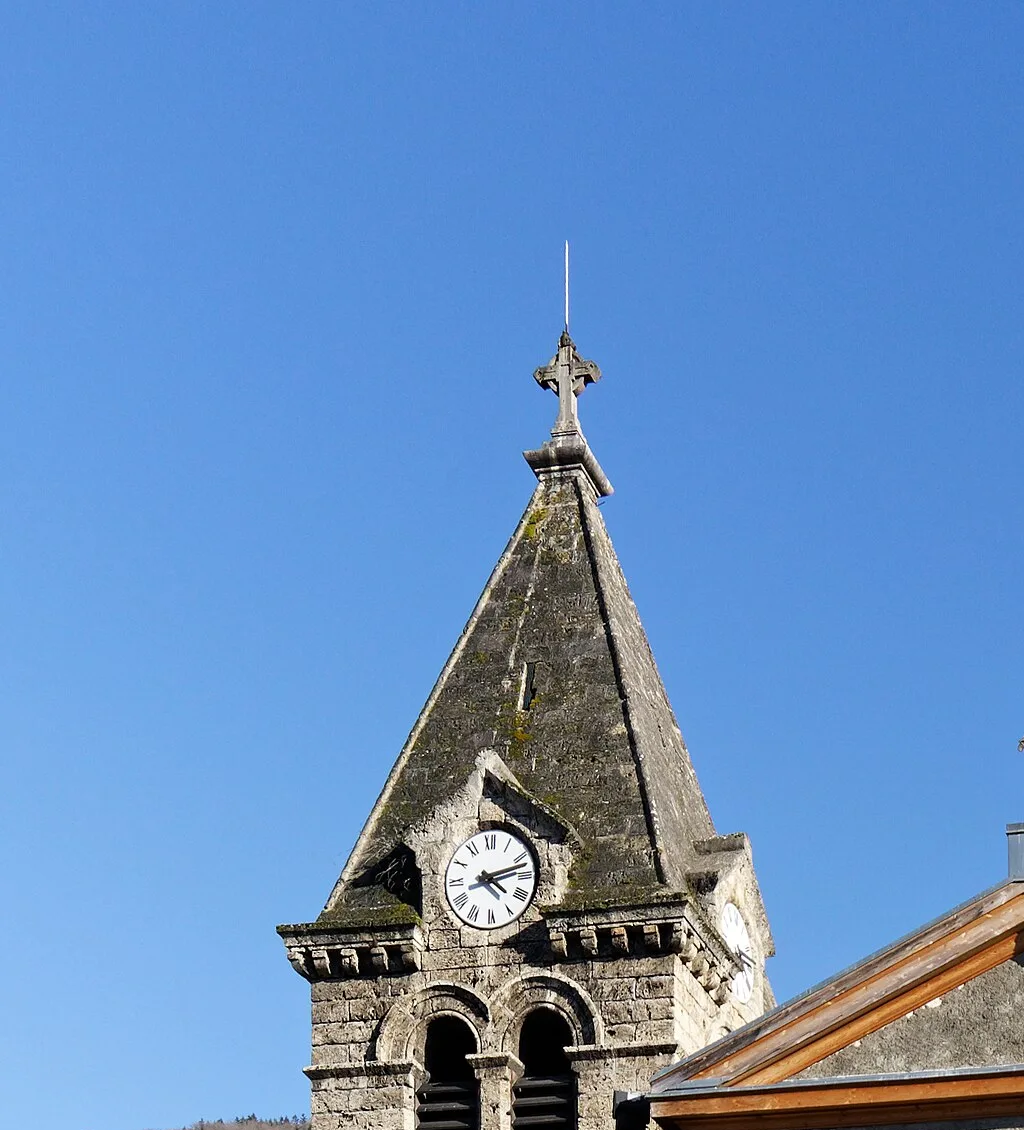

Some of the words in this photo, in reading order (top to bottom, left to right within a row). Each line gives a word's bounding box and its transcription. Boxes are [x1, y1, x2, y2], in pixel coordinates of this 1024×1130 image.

[466, 841, 479, 857] XI
[485, 834, 496, 850] XII
[454, 859, 468, 868] X
[514, 852, 528, 863] II
[449, 878, 464, 887] IX
[517, 871, 532, 880] III
[453, 892, 469, 911] VIII
[513, 887, 528, 902] IIII
[467, 904, 480, 922] VII
[488, 909, 495, 924] VI
[505, 904, 514, 917] V
